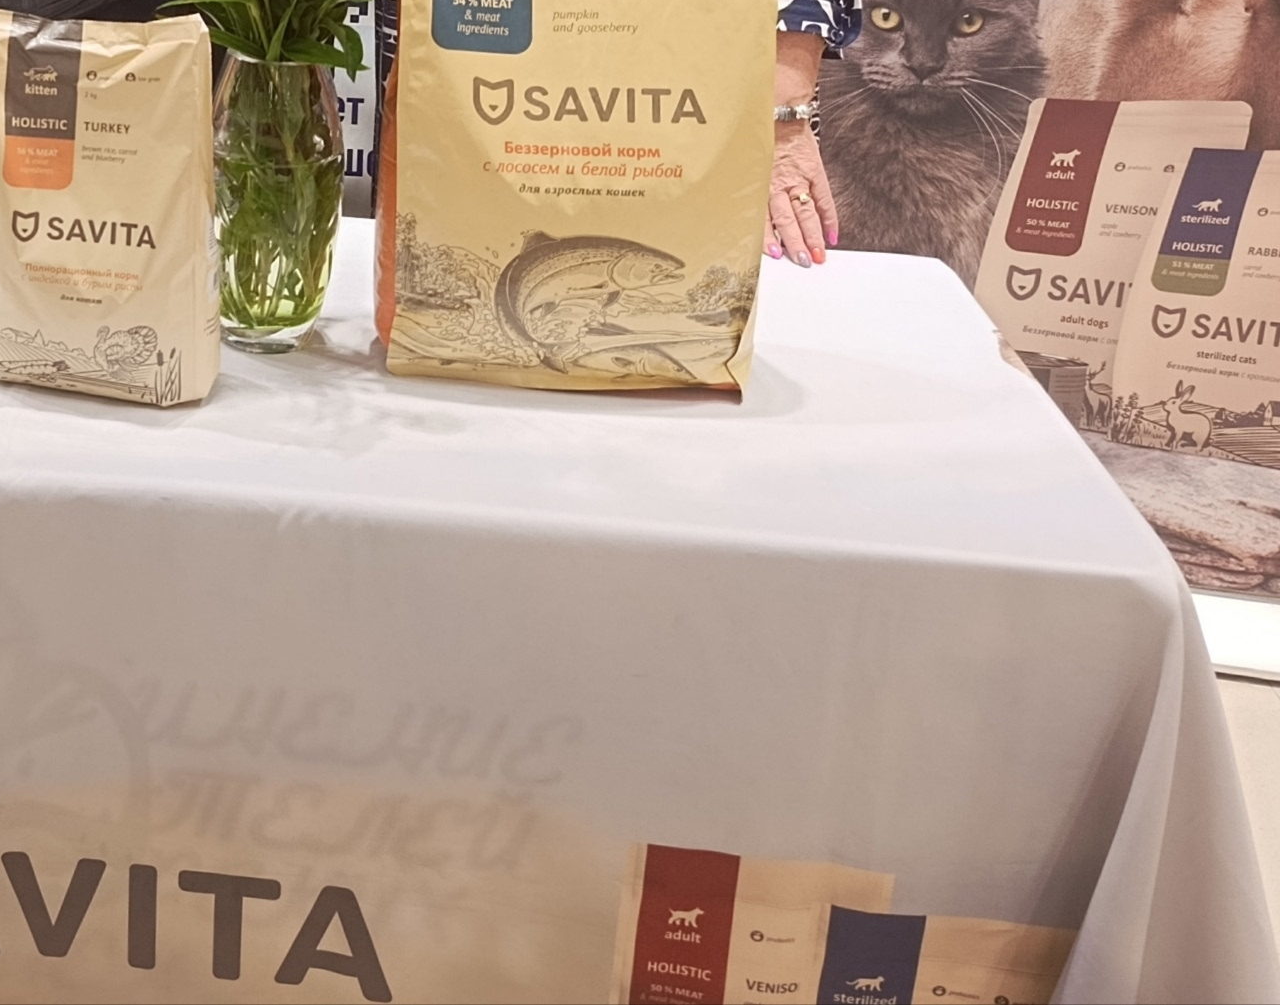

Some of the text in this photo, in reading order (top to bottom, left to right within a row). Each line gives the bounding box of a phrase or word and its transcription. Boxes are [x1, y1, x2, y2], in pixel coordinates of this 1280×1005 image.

[465, 10, 500, 21] & meat
[553, 11, 599, 21] pumpkin
[457, 22, 509, 35] ingredients
[553, 23, 638, 34] and gooseberry
[25, 83, 58, 95] kitten
[523, 85, 707, 125] SAVITA
[12, 116, 68, 130] HOLISTIC
[83, 121, 131, 134] TURKEY
[504, 141, 661, 161] Беззерновой корм
[483, 161, 683, 180] с лососем и белой рыбой
[1045, 170, 1076, 180] adult
[519, 183, 645, 197] для взрослых кошек
[1026, 198, 1080, 211] HOLISTIC
[1105, 204, 1158, 216] VENISON
[1026, 218, 1037, 226] 50
[1047, 220, 1070, 229] MEAT
[1181, 214, 1230, 225] sterilized
[47, 217, 156, 250] SAVITA
[1172, 241, 1223, 254] HOLISTIC
[25, 263, 139, 281] Полнорационный корм
[1192, 262, 1214, 270] MEAT
[1047, 275, 1132, 308] SAVI
[1060, 315, 1109, 329] adult dogs
[1196, 350, 1257, 365] sterilized cats
[665, 930, 701, 944] adult
[647, 961, 712, 981] HOLISTIC
[746, 978, 798, 994] VENISO
[675, 988, 704, 999] MEAT
[833, 993, 897, 1005] sterilized
